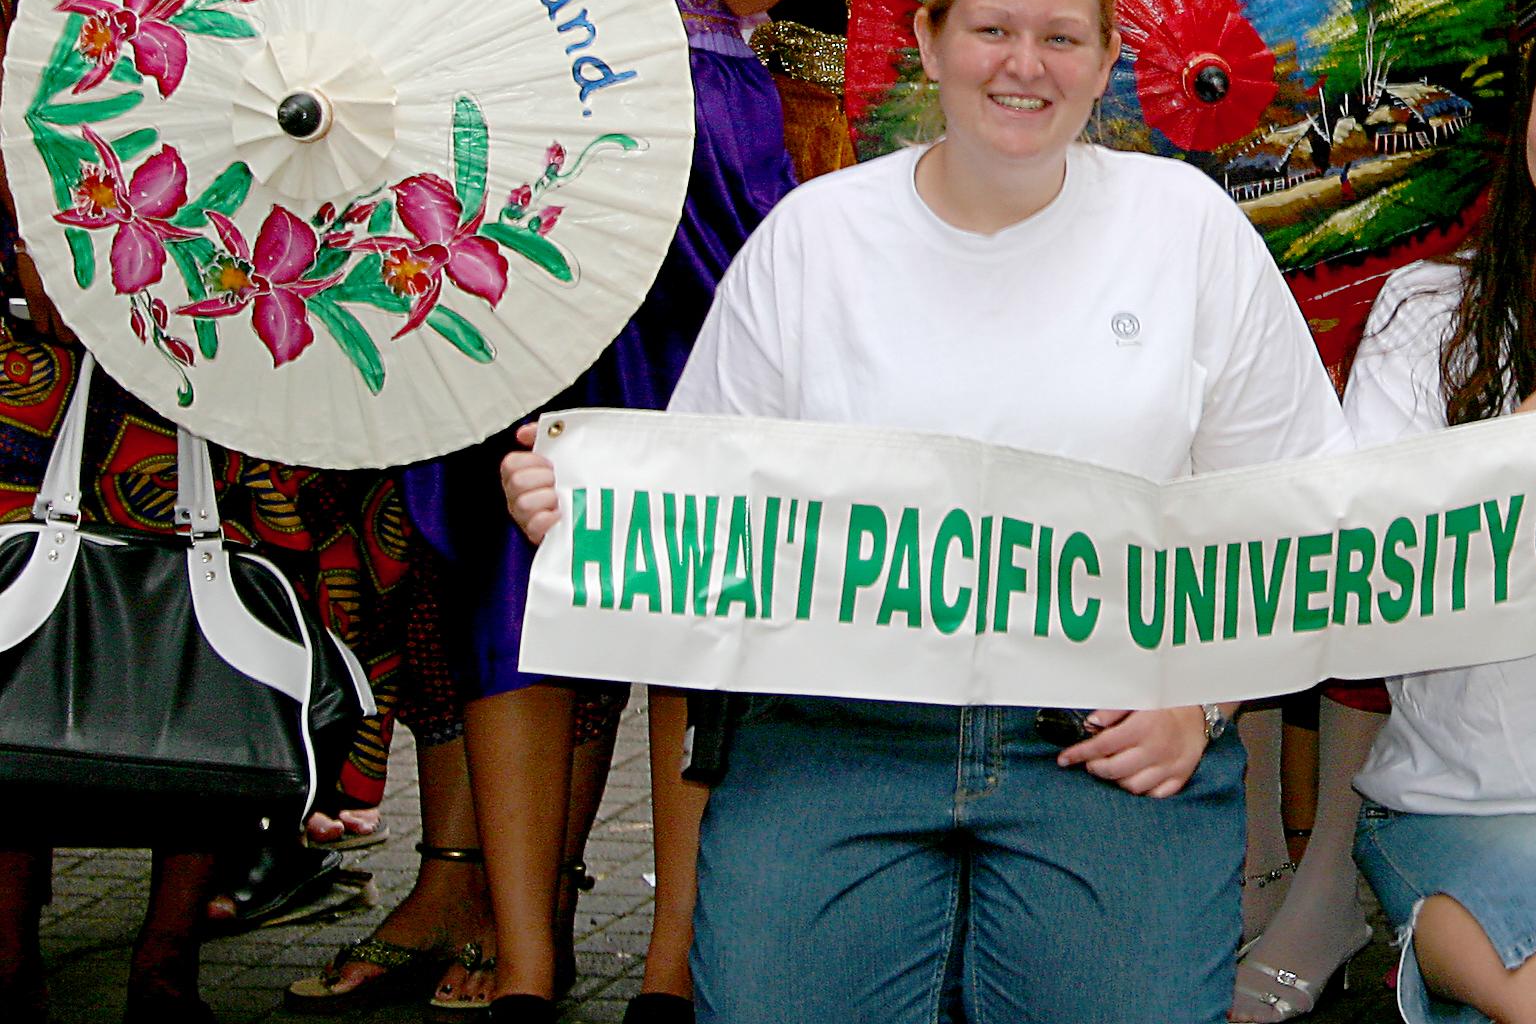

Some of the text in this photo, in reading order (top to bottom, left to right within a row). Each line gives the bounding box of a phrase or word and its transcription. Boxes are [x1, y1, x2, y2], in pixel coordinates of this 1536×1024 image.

[572, 488, 1525, 650] HAWAI'I PACIFIC UNIVERSITY
